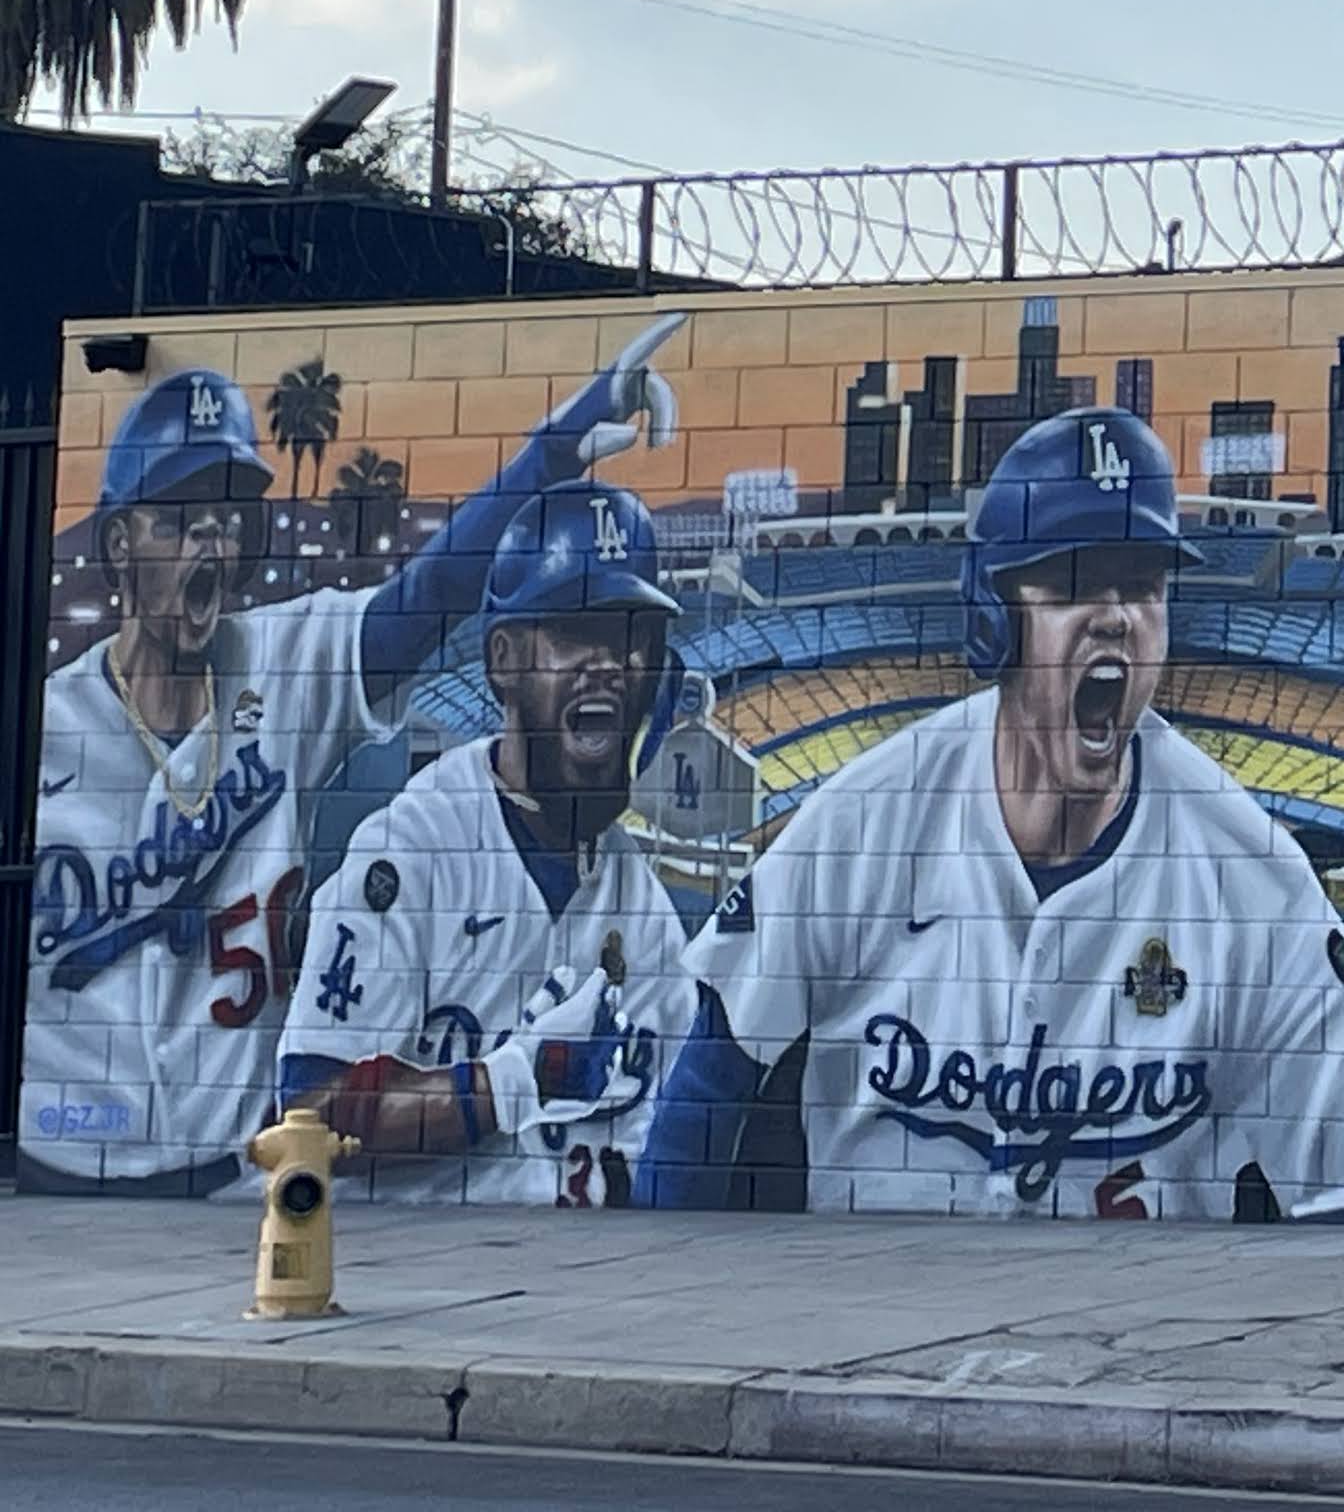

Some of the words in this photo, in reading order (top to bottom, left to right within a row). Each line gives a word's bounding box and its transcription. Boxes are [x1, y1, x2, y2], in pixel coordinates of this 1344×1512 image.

[190, 376, 223, 426] LA
[1088, 423, 1130, 491] LA
[589, 497, 628, 561] LA
[673, 752, 701, 810] LA
[316, 922, 364, 1022] LA
[864, 1013, 1212, 1202] Dodgers
